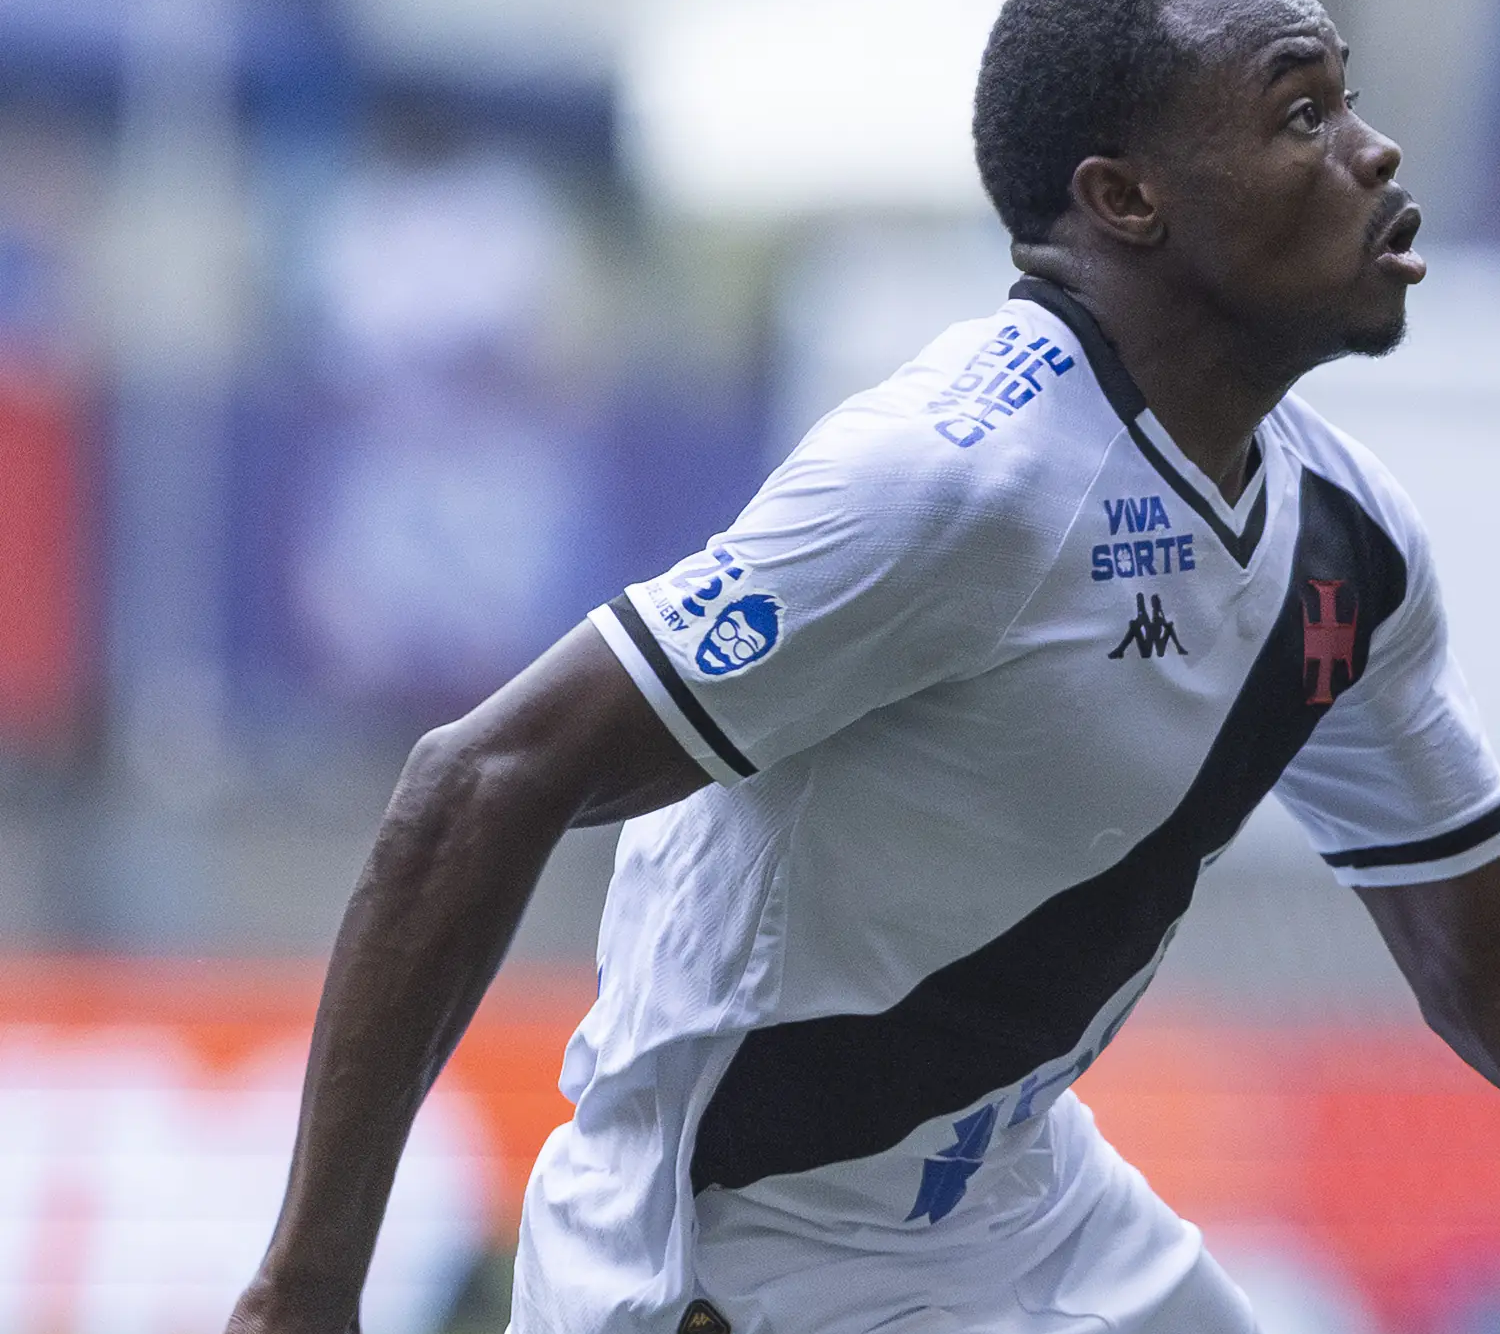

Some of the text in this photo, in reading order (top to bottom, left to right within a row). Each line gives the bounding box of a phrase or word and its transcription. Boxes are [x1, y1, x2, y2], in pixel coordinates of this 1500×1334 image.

[934, 336, 1075, 448] CHEFE
[1103, 496, 1172, 536] VIVA
[1091, 533, 1196, 581] SORTE
